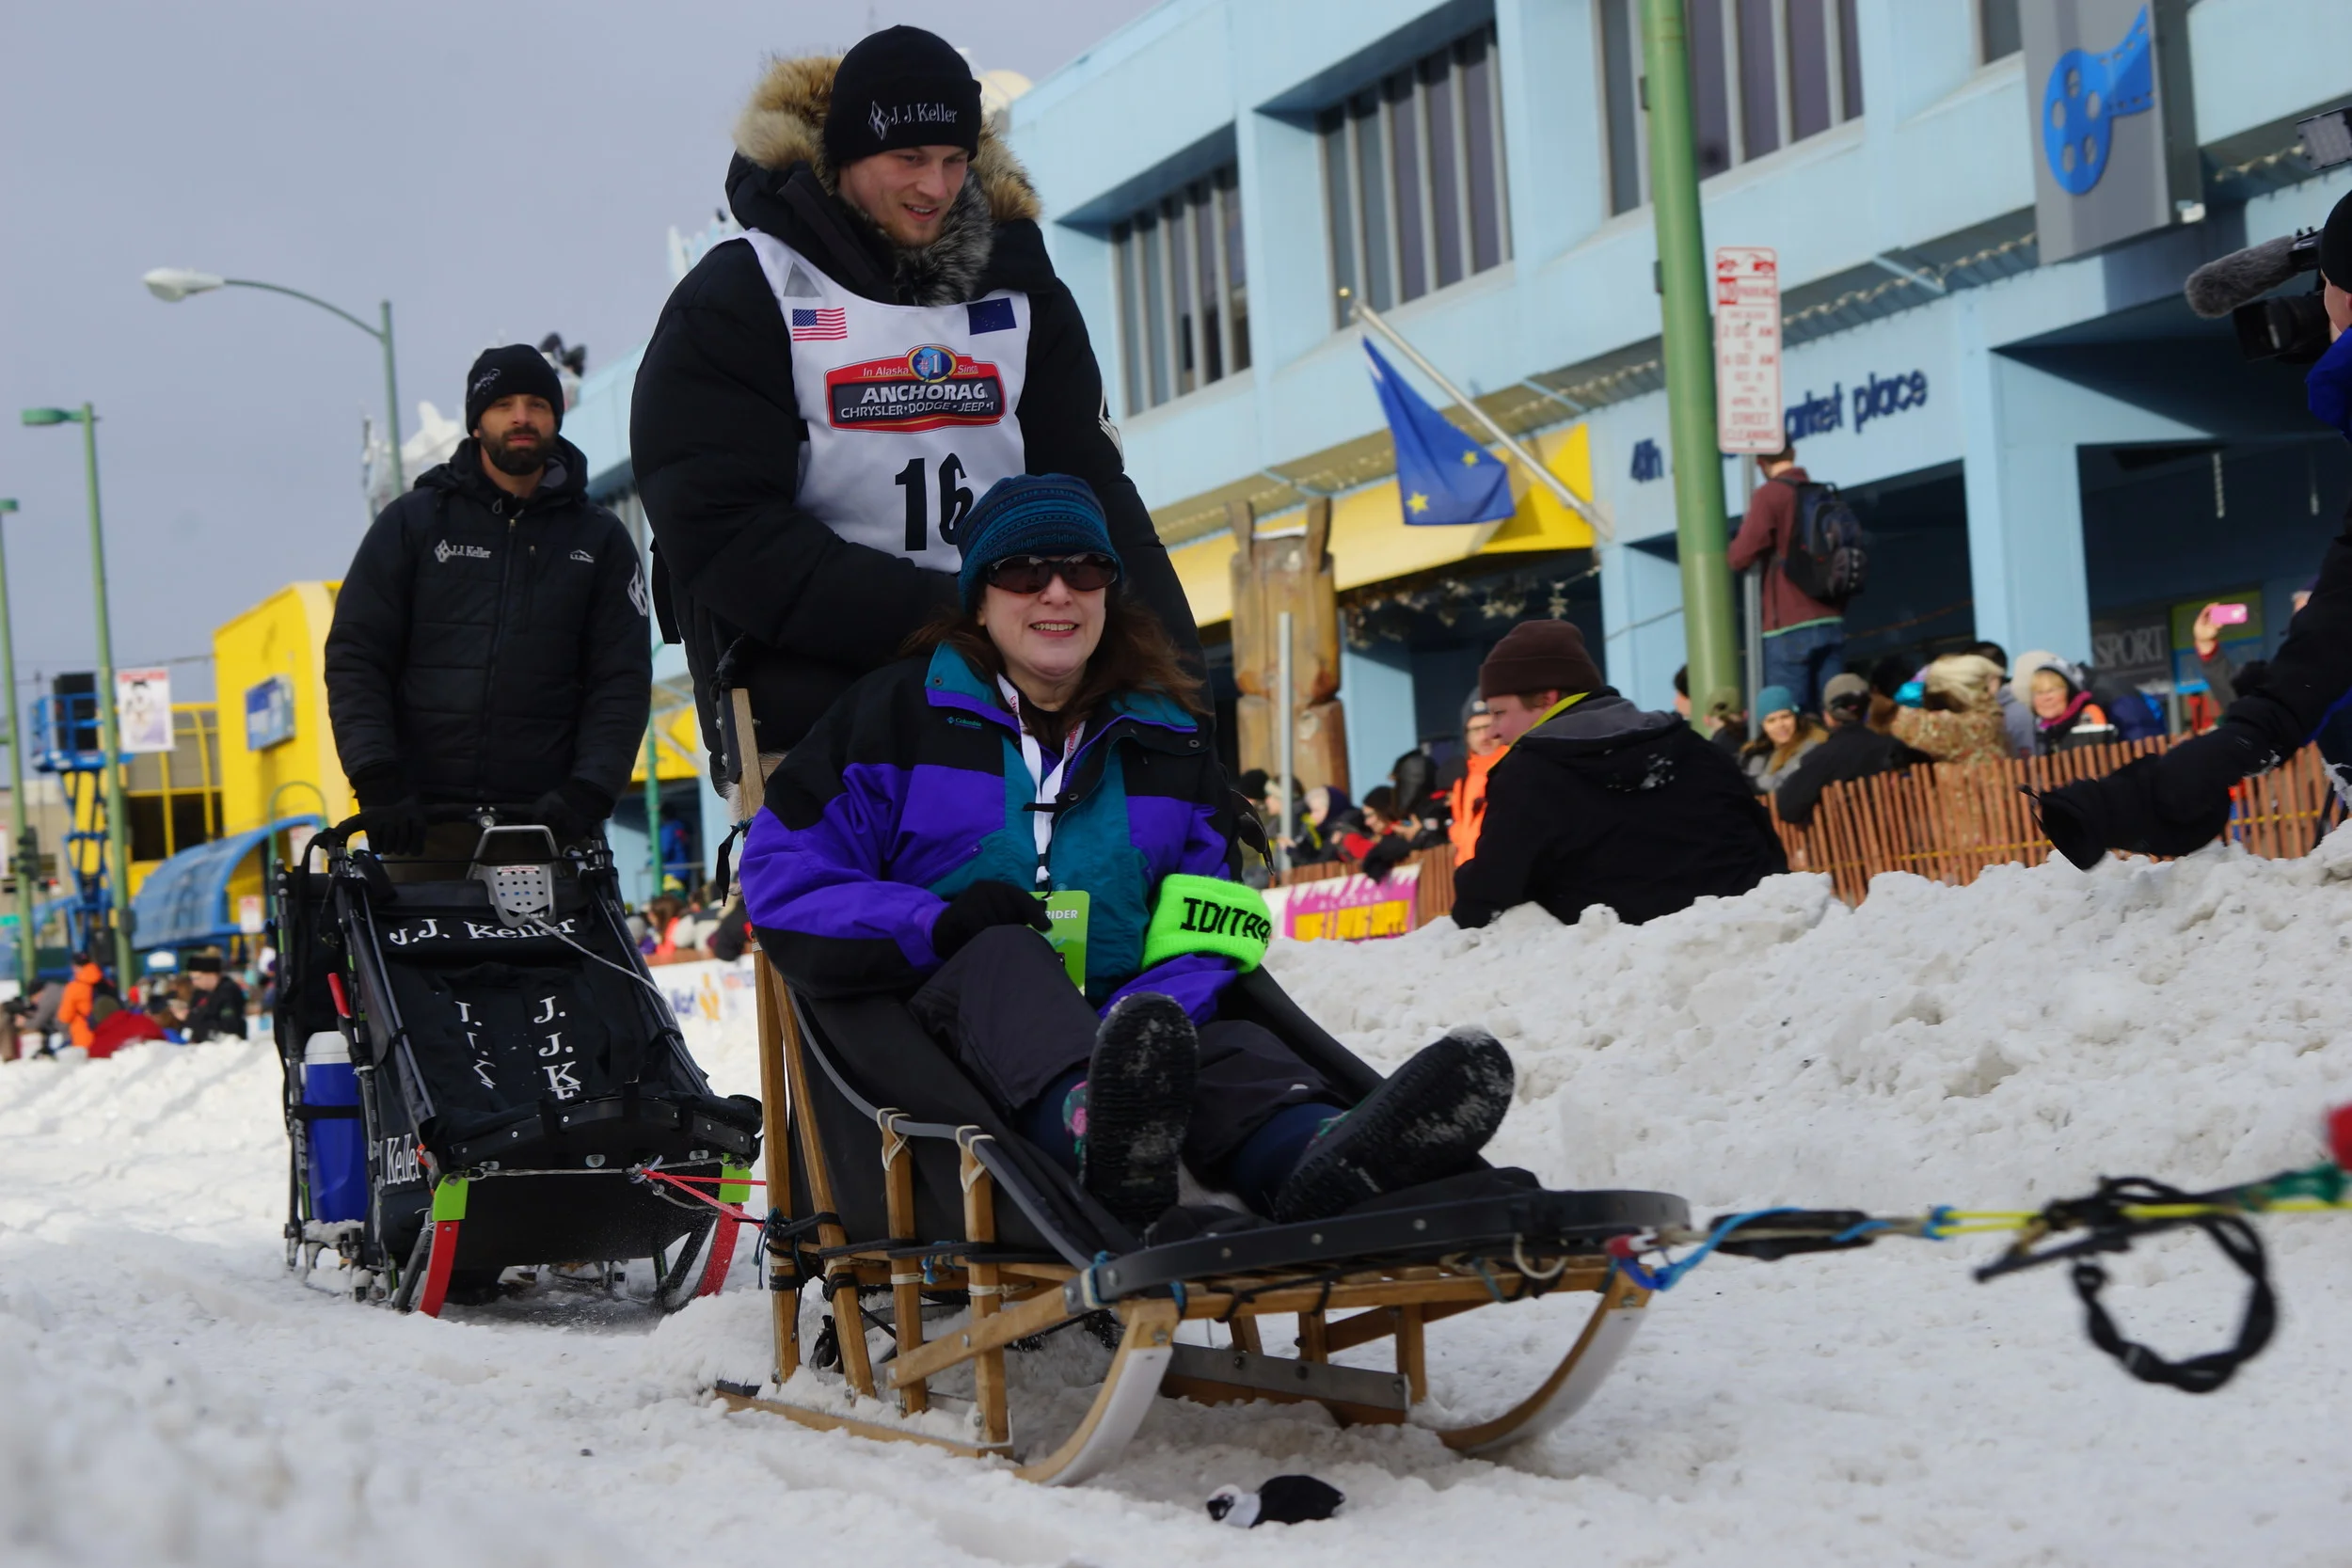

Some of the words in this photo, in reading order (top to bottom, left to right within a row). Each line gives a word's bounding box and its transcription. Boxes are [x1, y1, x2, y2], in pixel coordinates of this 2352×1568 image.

[916, 102, 958, 123] Keller
[863, 367, 873, 377] In
[876, 364, 909, 376] Alaska
[860, 382, 988, 404] ANCHORAG
[841, 404, 903, 419] CHRYSLER
[909, 401, 950, 414] DODGE
[958, 401, 985, 412] JEEP
[1785, 381, 1844, 443] arket
[1851, 370, 1928, 435] place
[895, 452, 975, 552] 16
[466, 545, 492, 559] Keller
[463, 918, 576, 940] Keller
[386, 1132, 422, 1185] Keller
